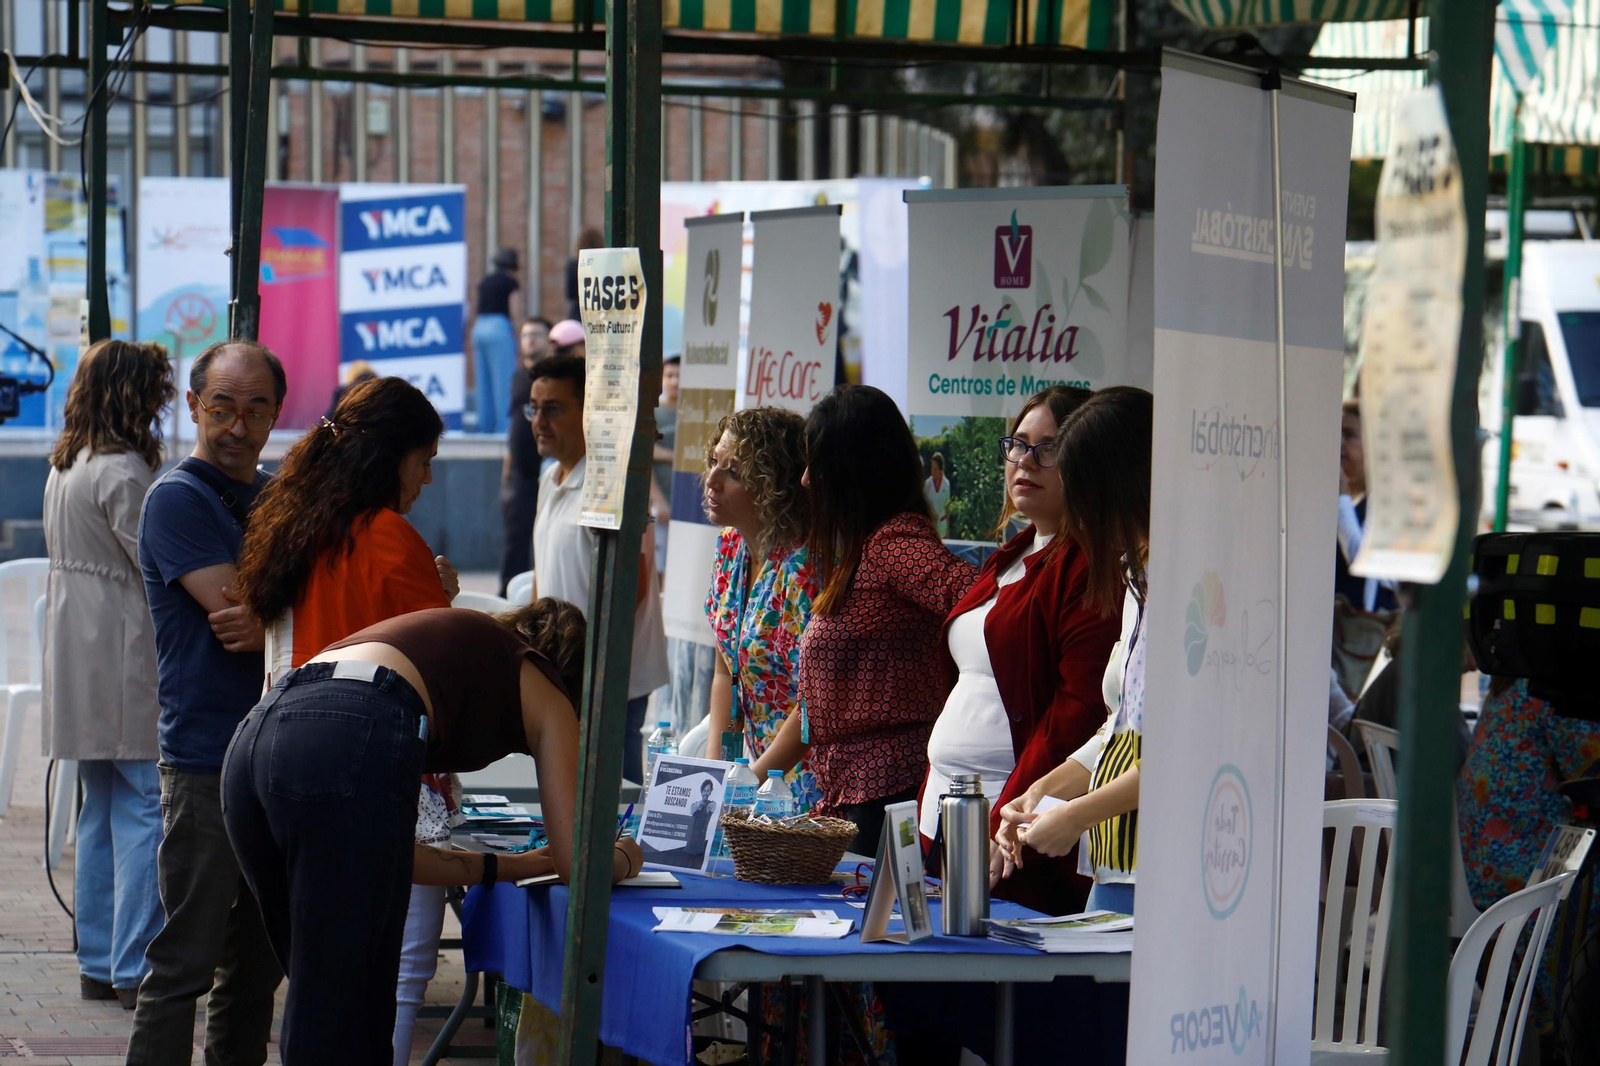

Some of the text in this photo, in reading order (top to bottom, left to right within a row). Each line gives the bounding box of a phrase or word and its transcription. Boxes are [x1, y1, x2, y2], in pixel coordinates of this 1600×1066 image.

[359, 205, 452, 240] YMCA
[1000, 235, 1028, 275] V
[361, 264, 448, 293] YMCA
[1000, 276, 1024, 285] HOME
[355, 316, 447, 351] YMCA
[943, 304, 1080, 363] Vitalia
[929, 373, 992, 395] Centros
[996, 374, 1016, 395] de
[664, 796, 688, 807] BUSCANDO
[665, 785, 692, 797] TE ESTAMOS
